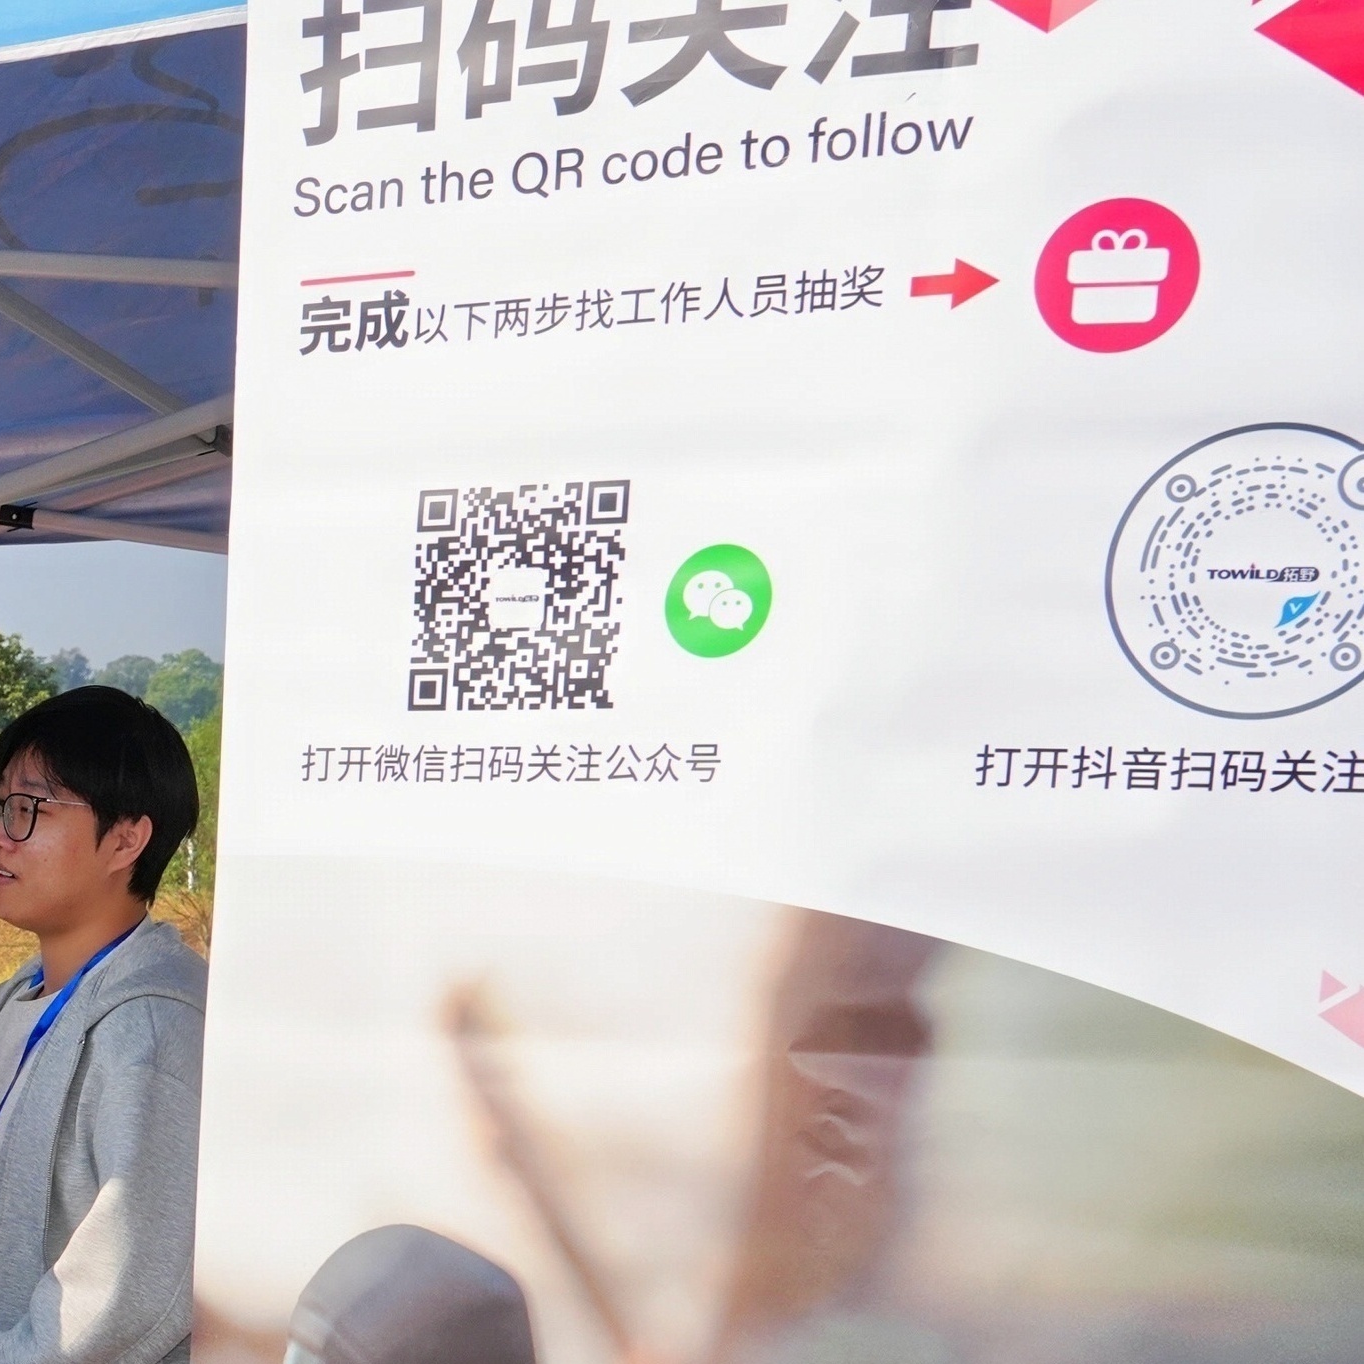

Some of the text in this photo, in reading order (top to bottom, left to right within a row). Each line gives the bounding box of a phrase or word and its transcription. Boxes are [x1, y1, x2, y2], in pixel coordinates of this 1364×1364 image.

[292, 111, 973, 218] Scan the QR code to follow
[301, 743, 722, 783] 打开微信扫码关注公众号
[975, 744, 1364, 793] 打开抖音扫码关注
